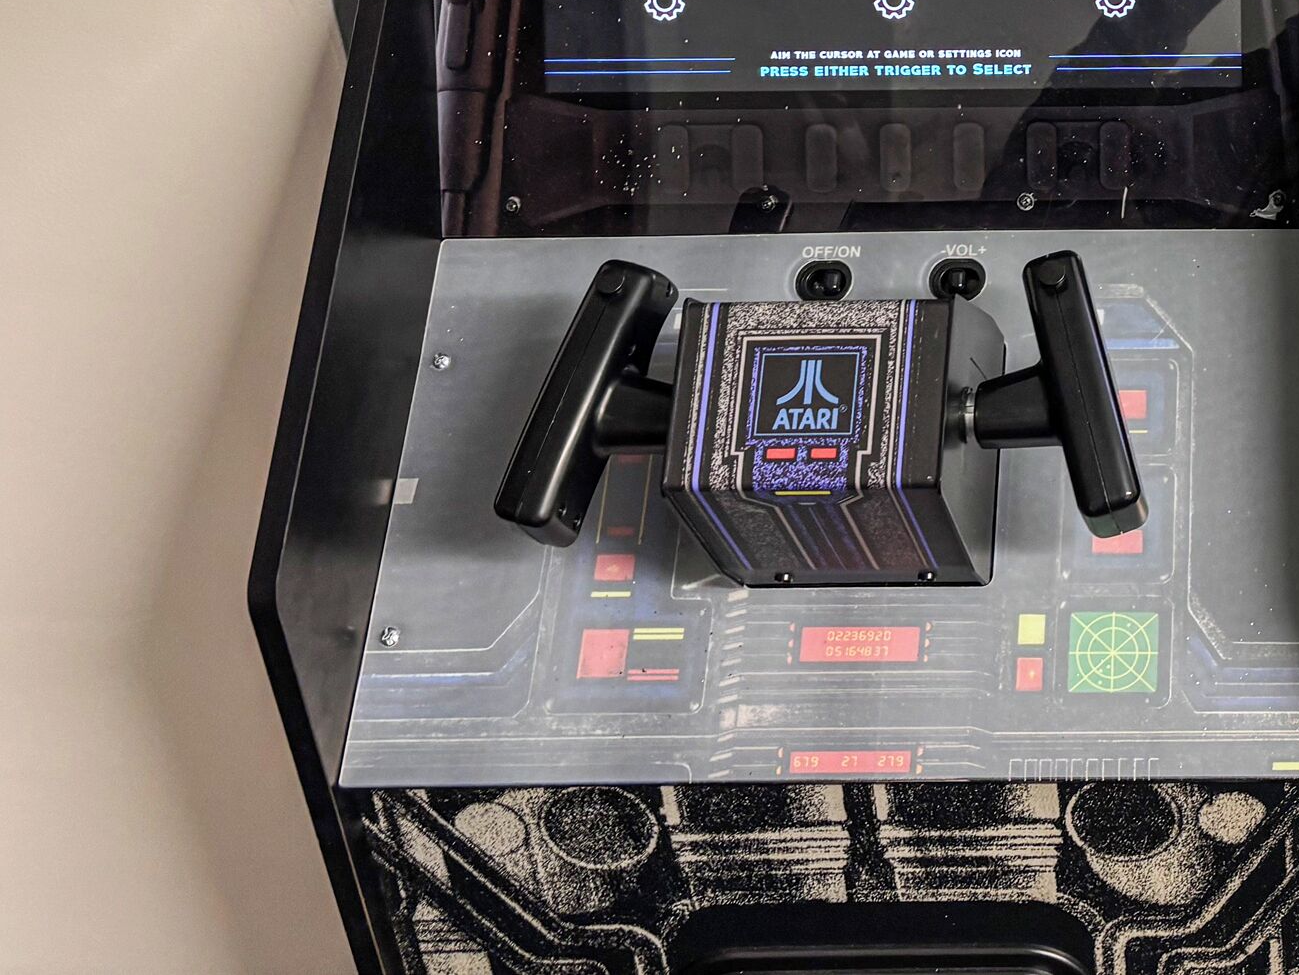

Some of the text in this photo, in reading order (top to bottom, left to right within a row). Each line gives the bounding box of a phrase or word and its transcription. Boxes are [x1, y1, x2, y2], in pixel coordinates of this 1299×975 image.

[770, 50, 1022, 59] AIM THE CURSOR AT GAME OR SETTINGS ICON
[760, 66, 808, 76] PRESS
[814, 65, 869, 76] EITHER
[874, 64, 942, 76] TRIGGER
[946, 64, 966, 75] TO
[802, 246, 862, 258] OFF/ON
[827, 630, 892, 642] 02236920
[841, 756, 858, 767] 27
[877, 756, 904, 766] 279
